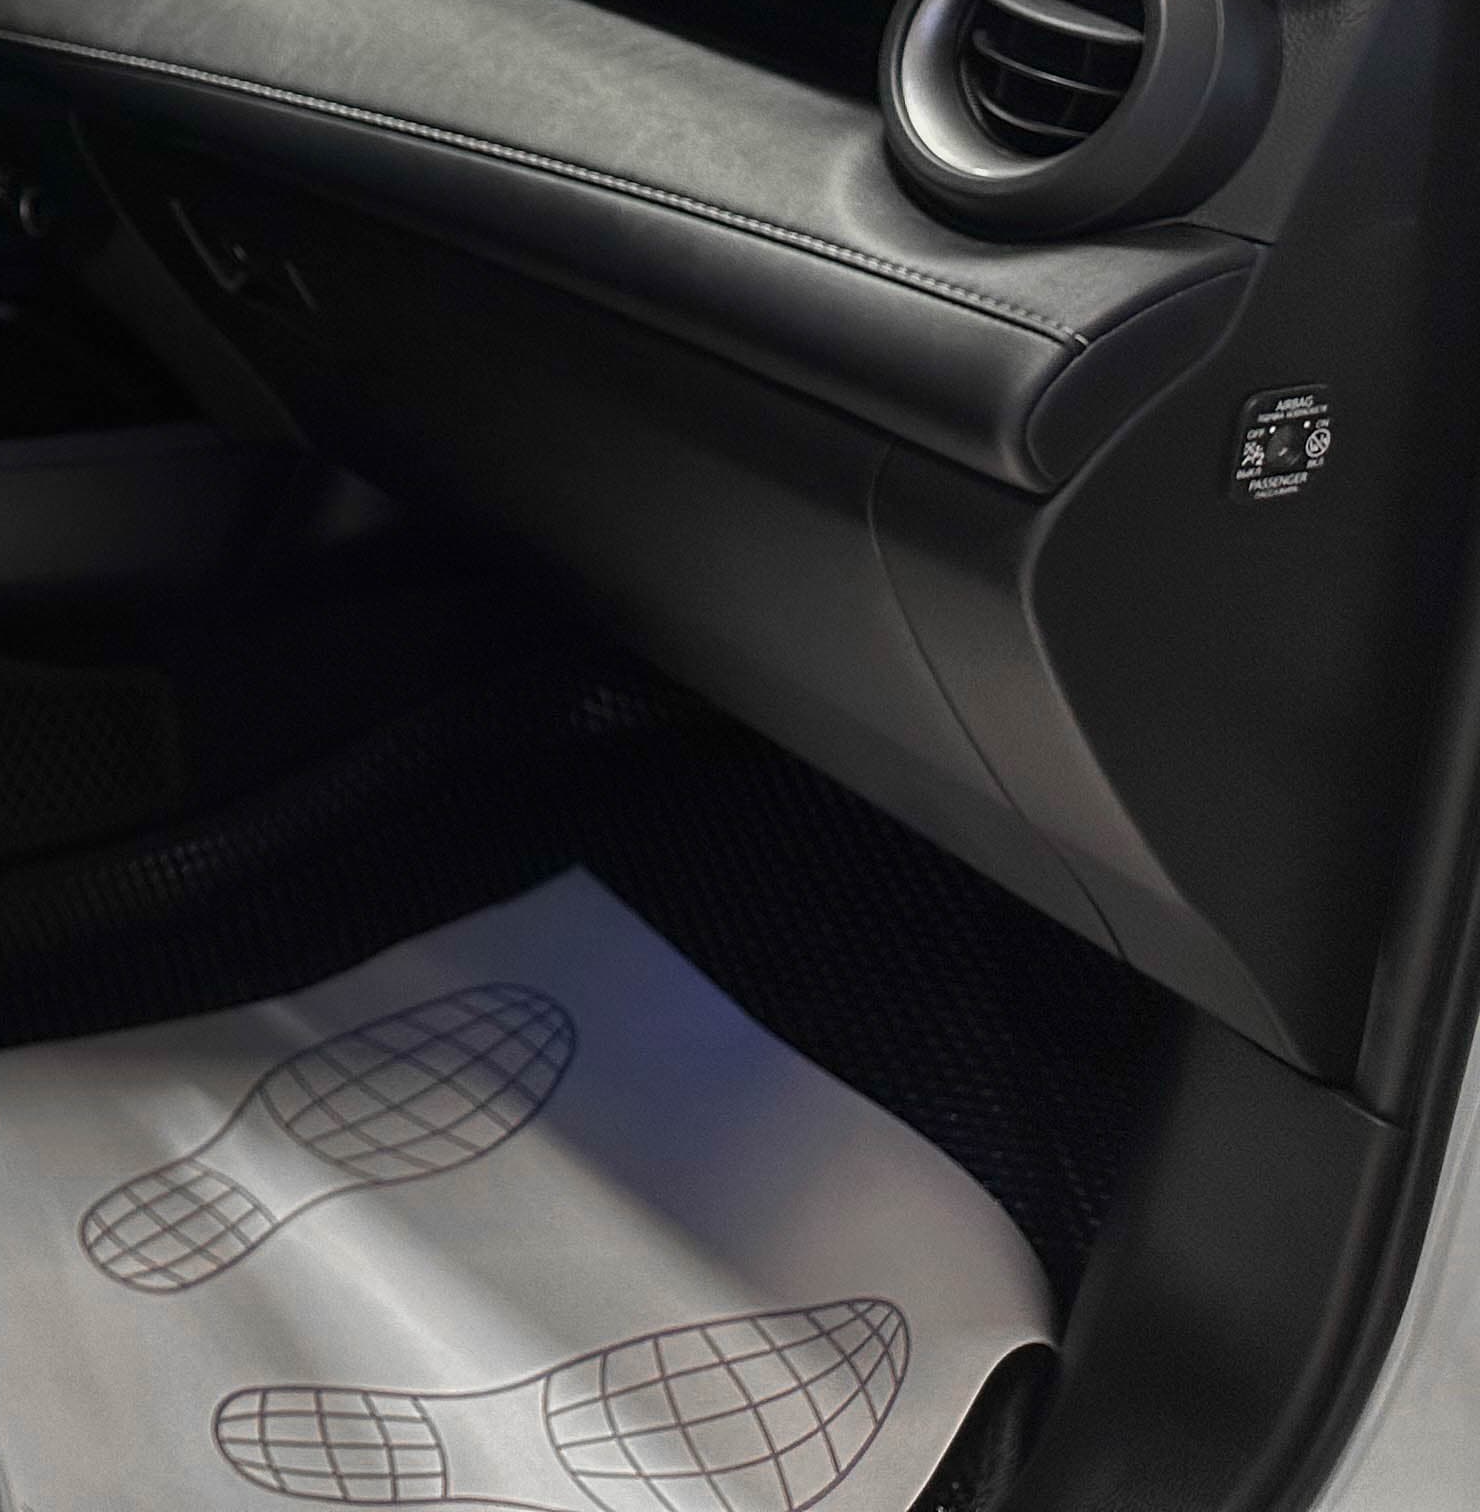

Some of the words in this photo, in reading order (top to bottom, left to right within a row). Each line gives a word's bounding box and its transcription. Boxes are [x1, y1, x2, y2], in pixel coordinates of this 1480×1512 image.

[1275, 395, 1314, 412] AIRBAG
[1246, 428, 1265, 440] OFF
[1248, 472, 1308, 492] PASSENGER
